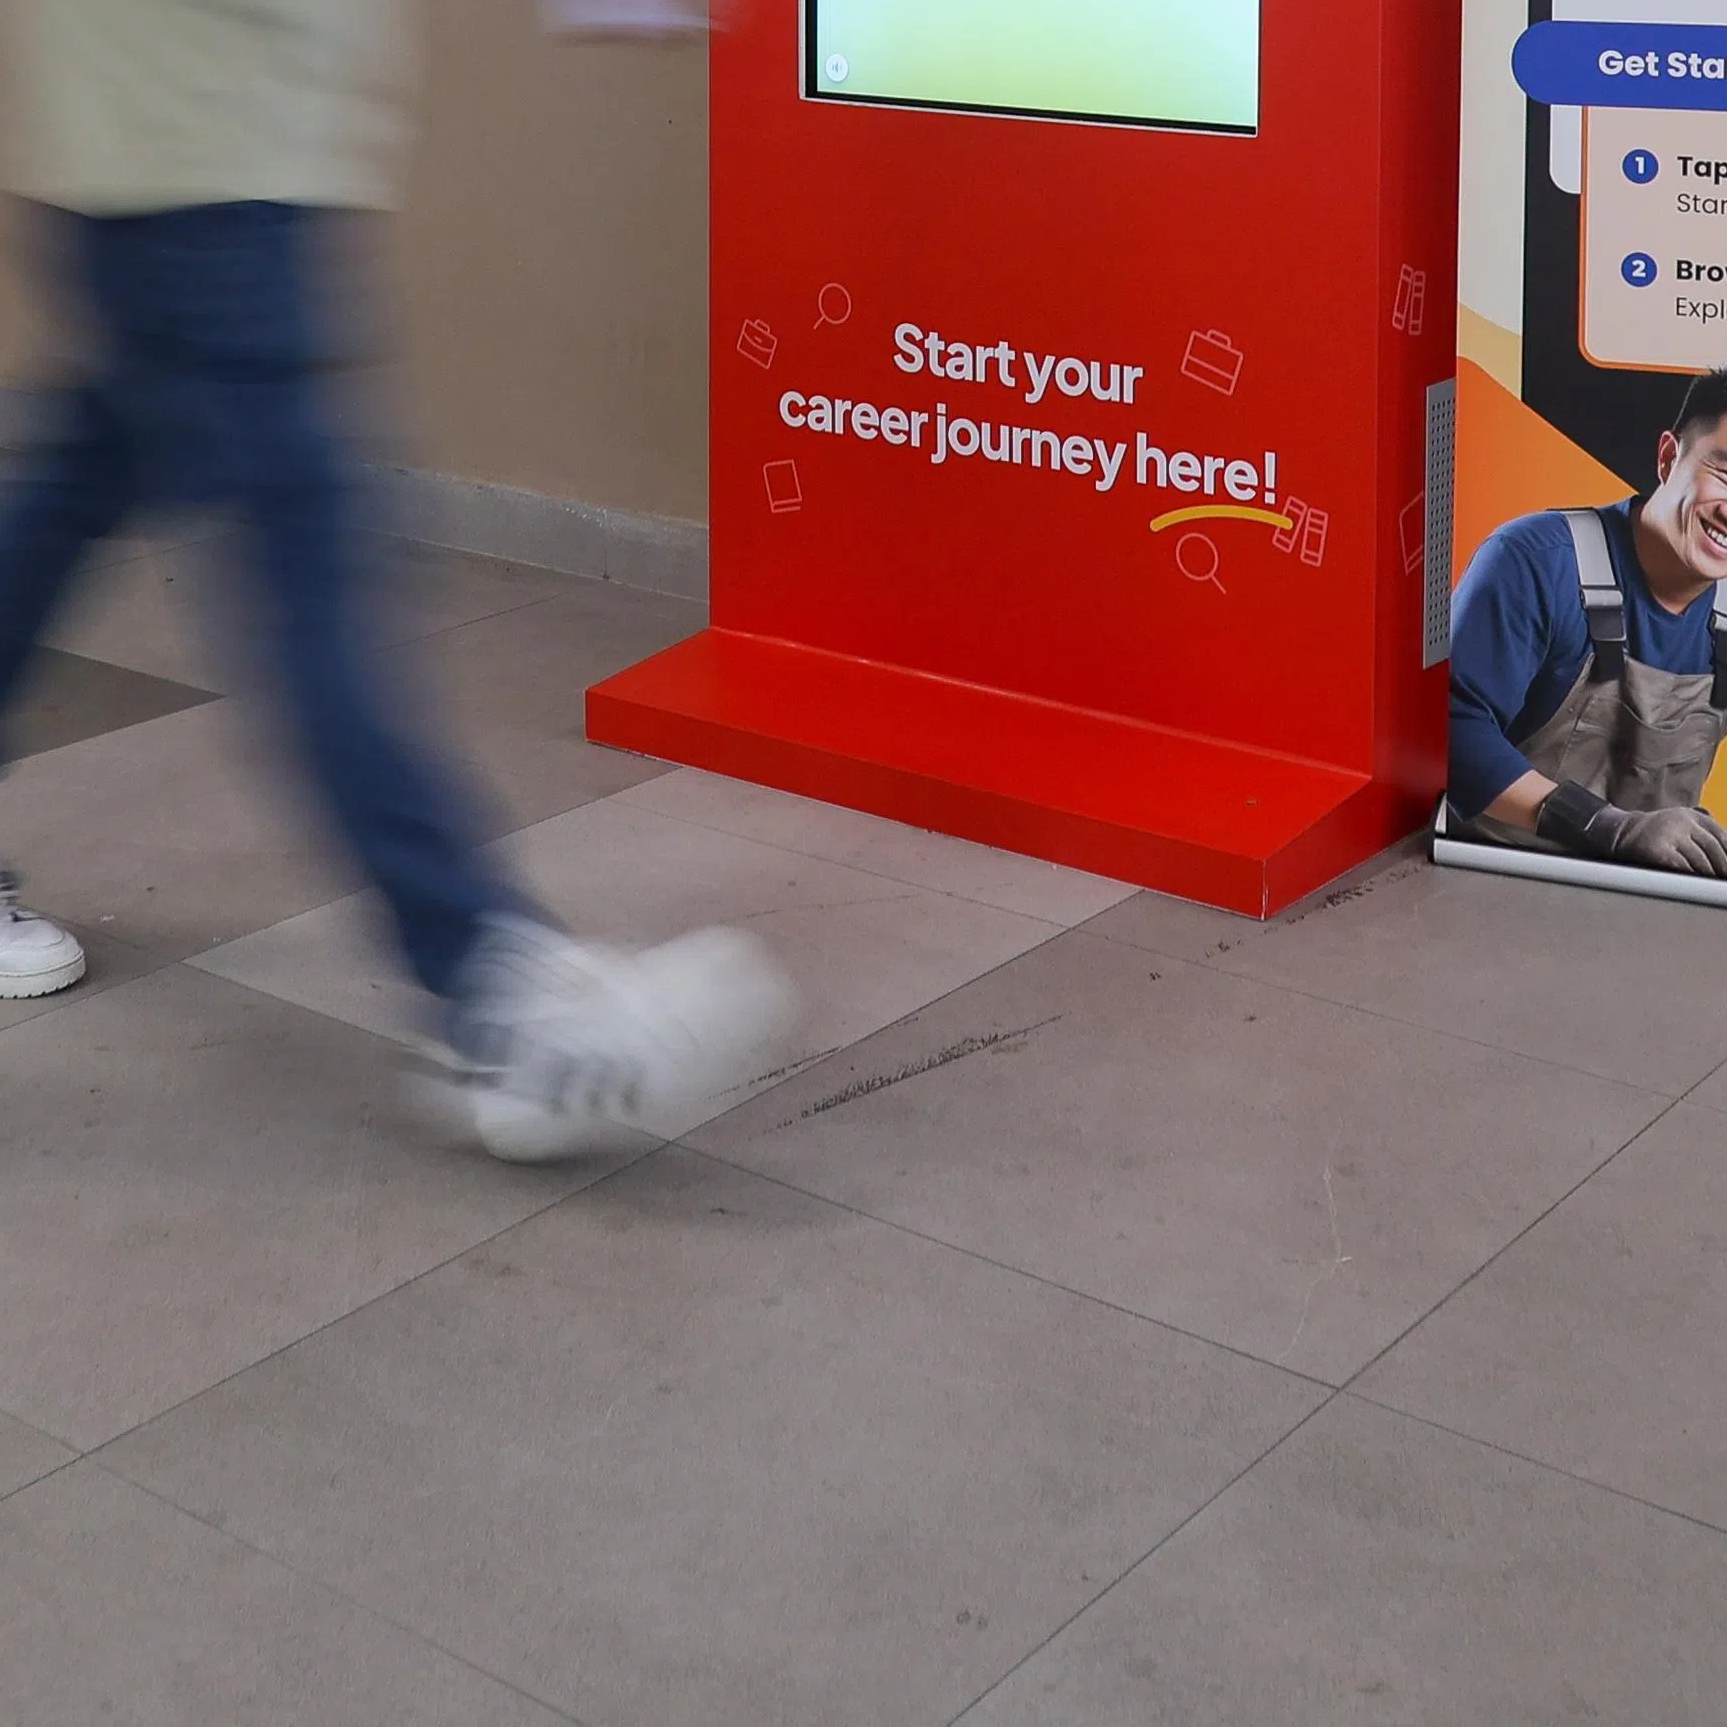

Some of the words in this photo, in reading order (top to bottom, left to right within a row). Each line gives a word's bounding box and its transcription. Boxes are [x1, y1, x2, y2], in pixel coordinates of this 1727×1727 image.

[1599, 50, 1659, 76] Get
[1635, 157, 1644, 174] 1
[1632, 260, 1646, 277] 2
[894, 323, 1017, 387] Start
[1024, 352, 1144, 403] your
[780, 391, 930, 447] career
[931, 403, 1127, 491] journey
[1137, 432, 1277, 504] here!
